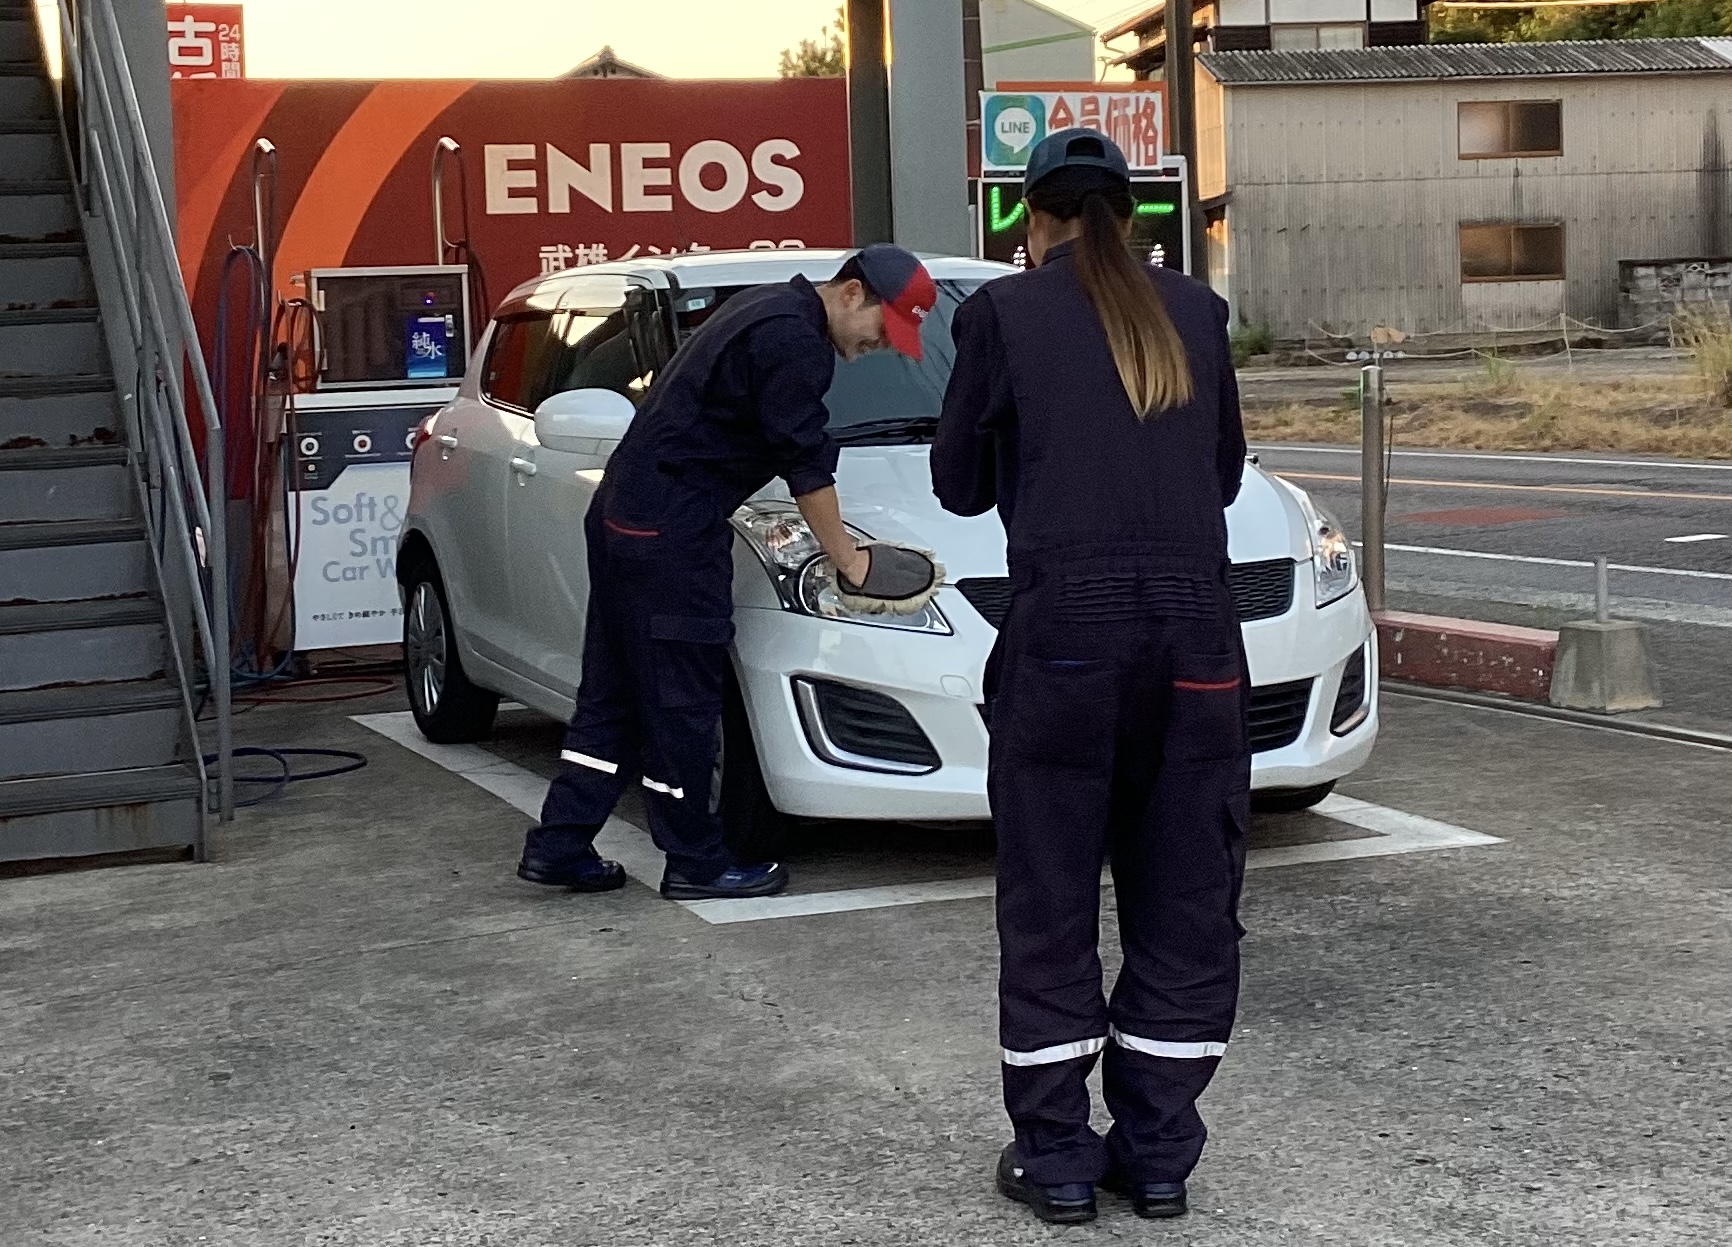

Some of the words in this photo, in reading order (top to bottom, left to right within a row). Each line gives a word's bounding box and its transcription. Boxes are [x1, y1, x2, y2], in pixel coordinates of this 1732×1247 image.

[1001, 121, 1030, 134] LINE
[484, 139, 804, 214] ENEOS
[322, 561, 369, 582] Car
